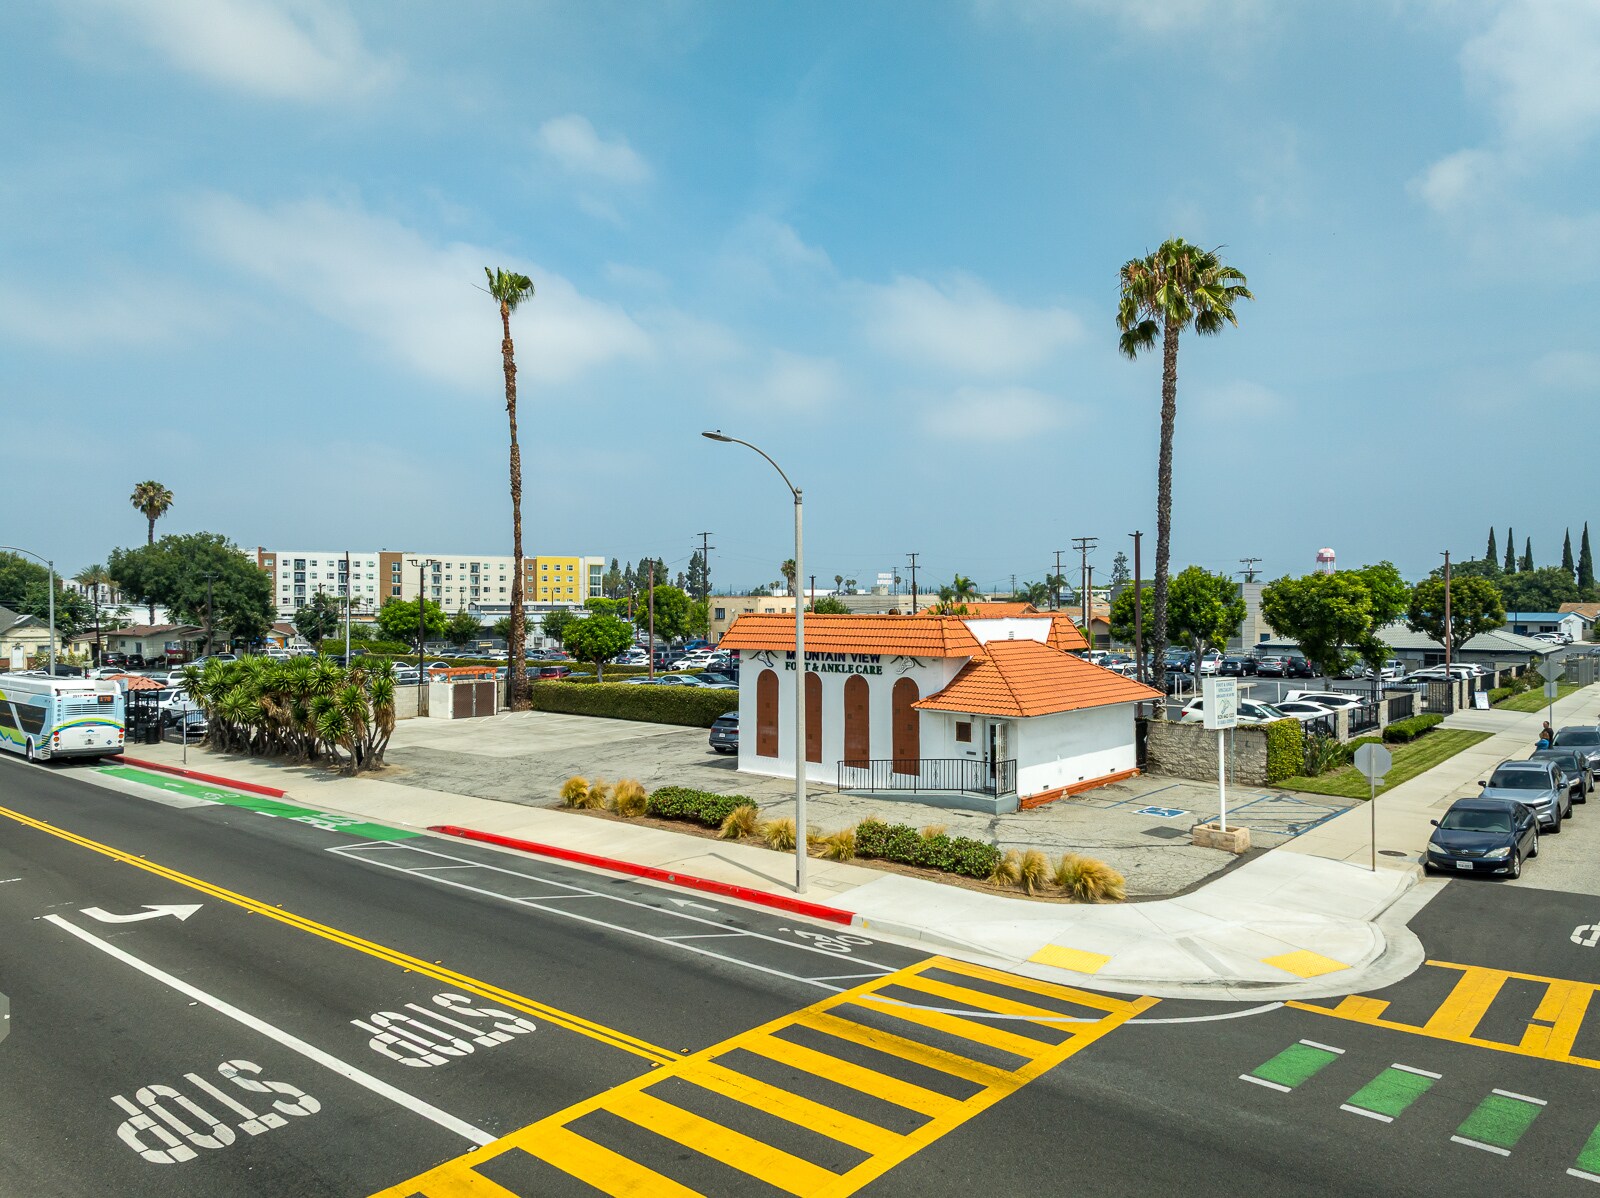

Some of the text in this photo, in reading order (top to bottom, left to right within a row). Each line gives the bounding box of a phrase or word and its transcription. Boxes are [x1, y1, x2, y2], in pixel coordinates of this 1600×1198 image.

[785, 661, 883, 675] FOT & ANKLE CARE
[786, 650, 881, 663] MUNTAIN VIEW
[350, 993, 537, 1068] STOP
[110, 1059, 322, 1164] STOP
